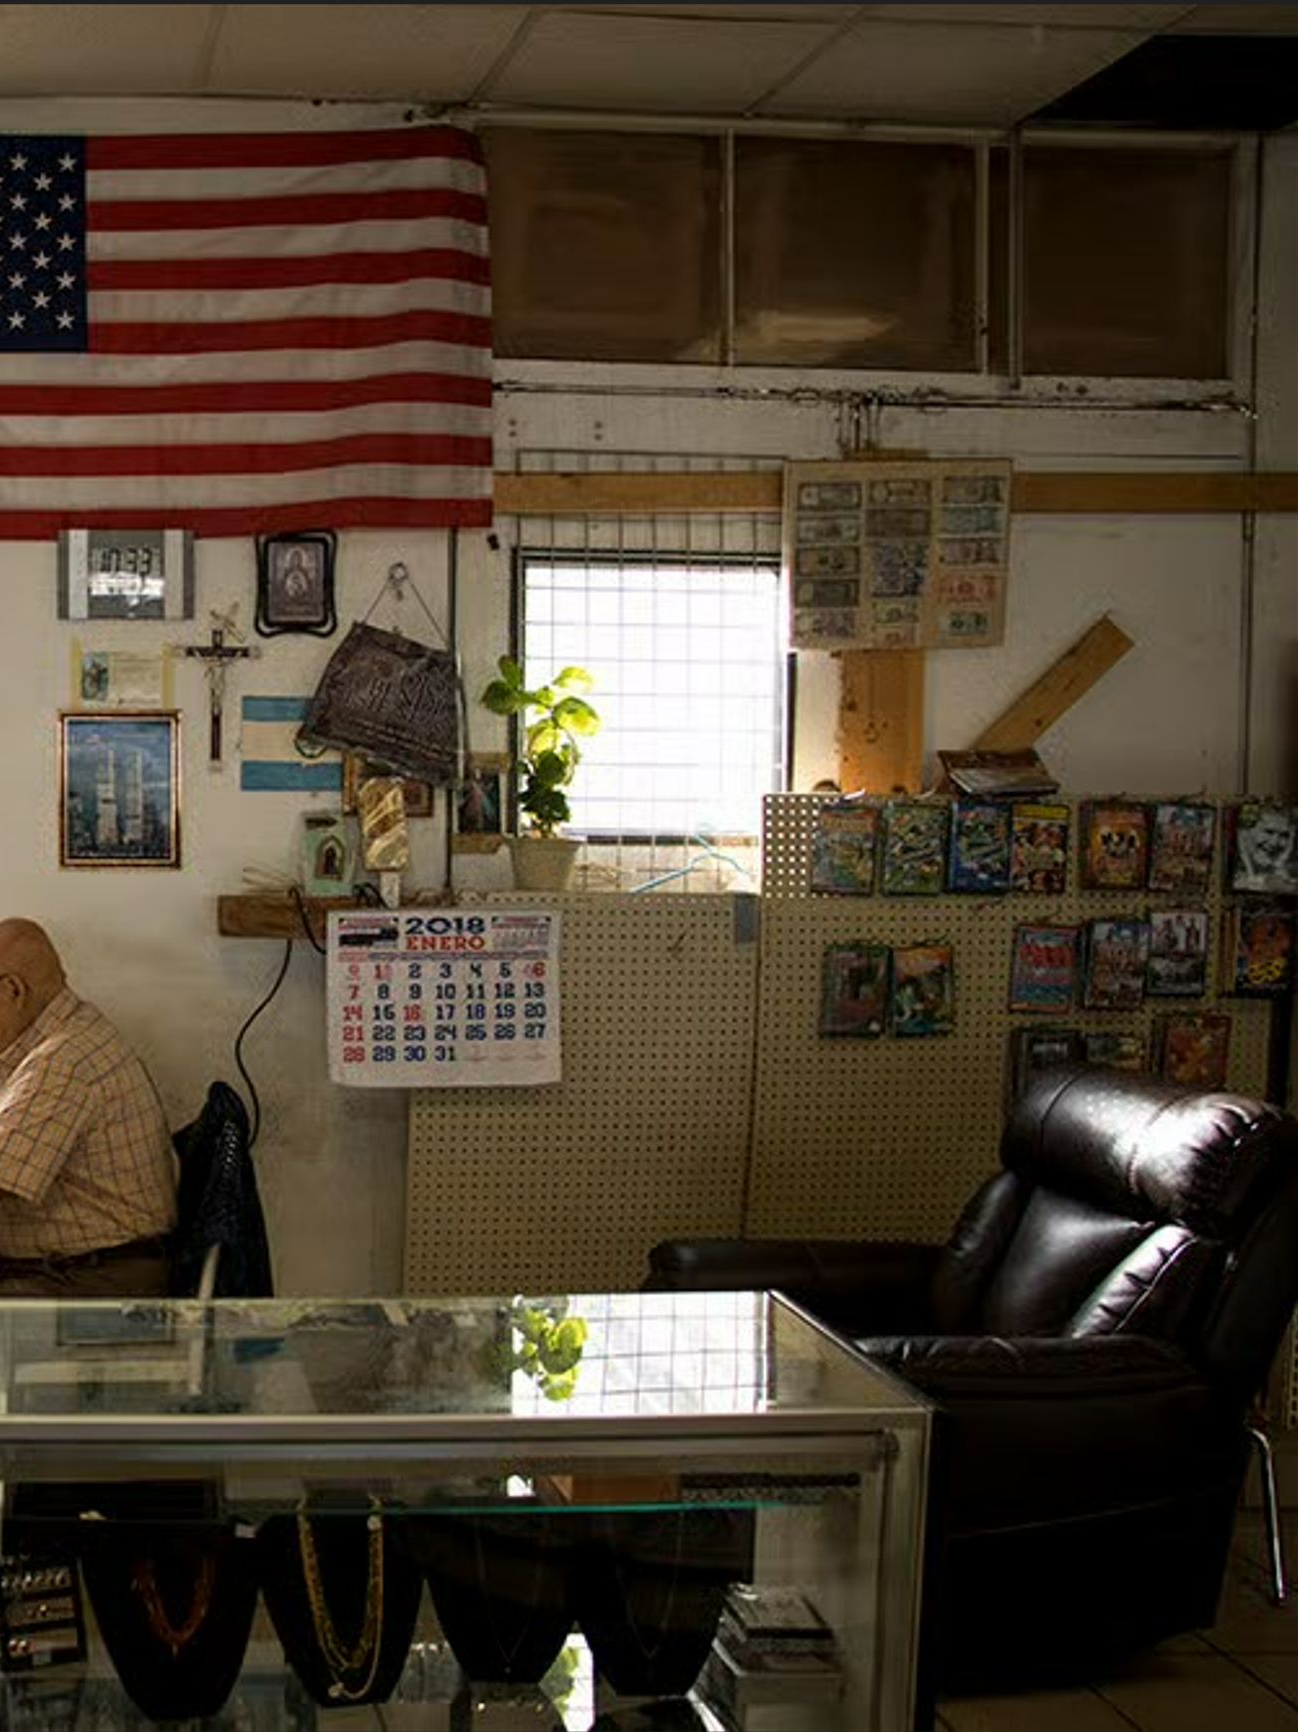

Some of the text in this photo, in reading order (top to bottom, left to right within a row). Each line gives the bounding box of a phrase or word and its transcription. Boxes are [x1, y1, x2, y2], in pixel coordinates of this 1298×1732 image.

[405, 917, 485, 935] 2018
[405, 936, 485, 951] ENERO
[409, 963, 421, 978] 2
[440, 963, 451, 978] 3
[500, 963, 511, 978] 5
[533, 963, 545, 978] 6
[349, 983, 544, 999] 7 8 9 10 11 12 13
[343, 1004, 362, 1020] 14
[404, 1004, 422, 1021] 16
[436, 1004, 455, 1020] 17
[467, 1004, 486, 1020] 18
[495, 1004, 515, 1020] 19
[525, 1004, 546, 1020] 20
[343, 1025, 363, 1040] 21
[373, 1025, 396, 1040] 22
[404, 1025, 425, 1040] 23
[435, 1025, 456, 1040] 24
[525, 1025, 546, 1040] 27
[343, 1046, 456, 1061] 28 29 30 31
